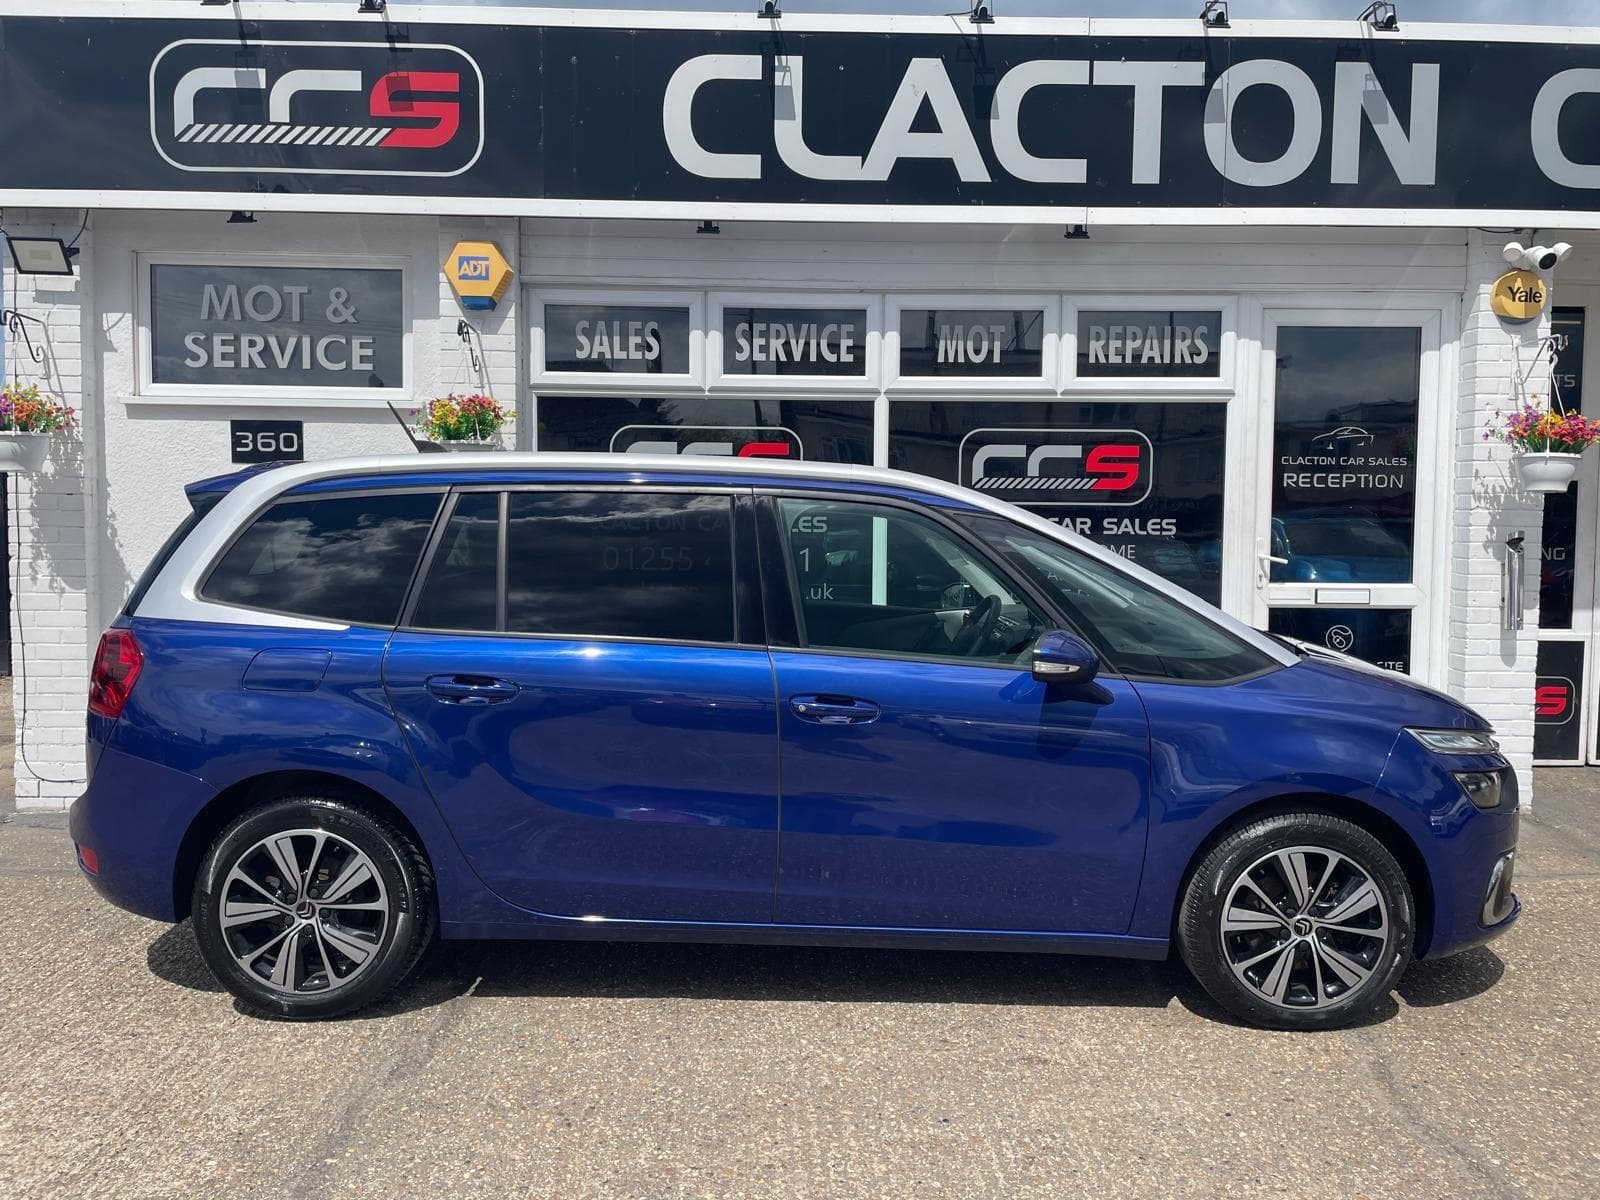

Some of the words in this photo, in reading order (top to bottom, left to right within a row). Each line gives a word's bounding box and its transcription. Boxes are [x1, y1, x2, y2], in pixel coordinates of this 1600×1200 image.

[662, 53, 1440, 187] CLACTON
[459, 260, 491, 277] ADT
[200, 283, 310, 323] MOT
[325, 286, 359, 324] &
[1507, 286, 1543, 304] Yale
[183, 330, 376, 372] SERVICE
[575, 320, 662, 361] SALES
[735, 322, 855, 363] SERVICE
[937, 324, 1006, 364] MOT
[1088, 325, 1209, 365] REPAIRS
[235, 432, 298, 452] 360
[1281, 456, 1336, 465] CLACTON
[1340, 456, 1364, 466] CAR
[1368, 457, 1408, 466] SALES
[1283, 472, 1404, 489] RECEPTION
[1102, 517, 1177, 536] SALES
